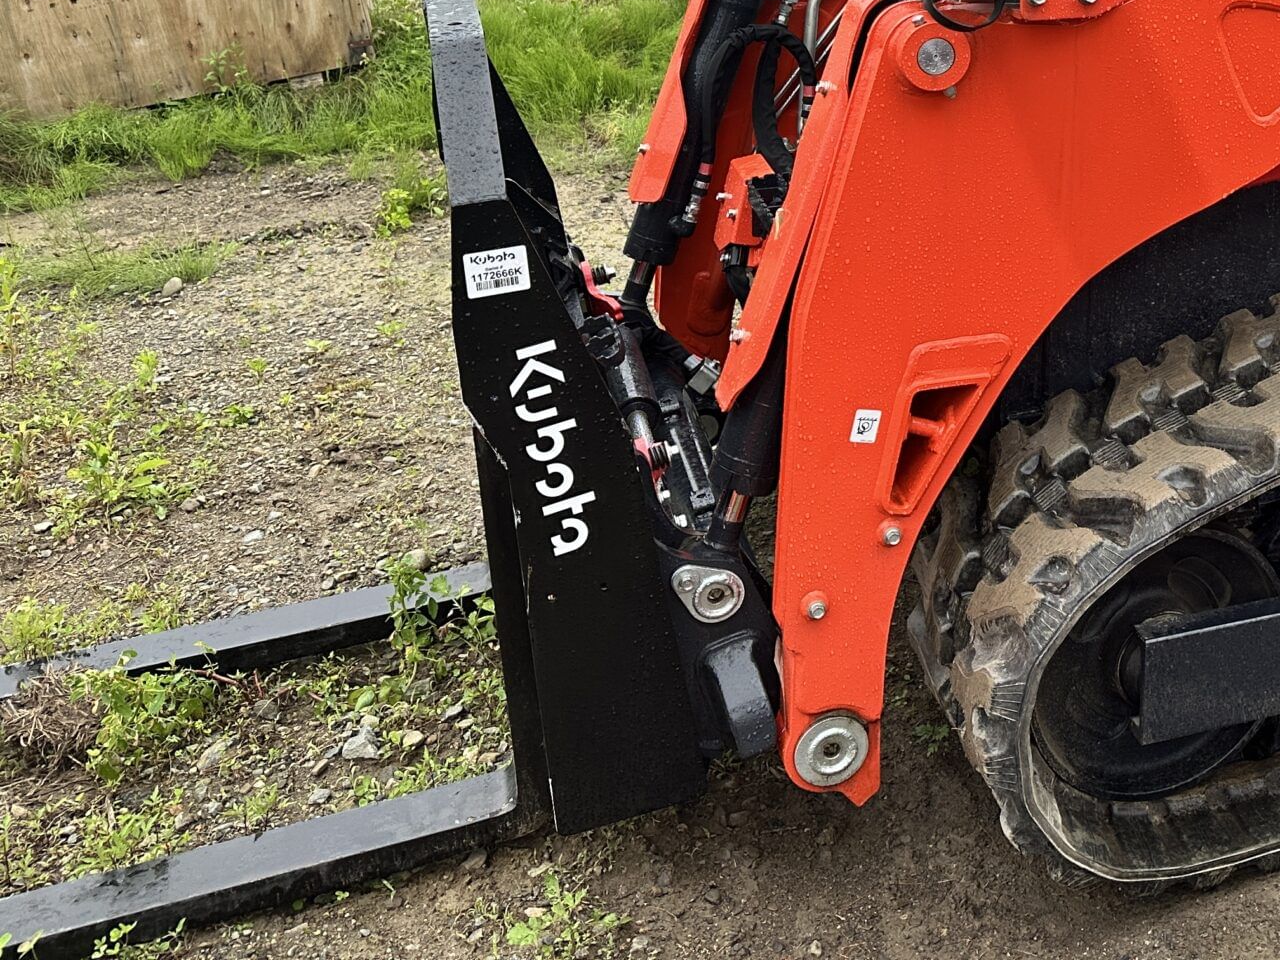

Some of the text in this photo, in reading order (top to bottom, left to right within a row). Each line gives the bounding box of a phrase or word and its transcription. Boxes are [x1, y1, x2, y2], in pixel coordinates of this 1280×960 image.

[470, 251, 516, 265] Kubota
[472, 267, 522, 282] 1172666K
[509, 339, 597, 557] Kubota
